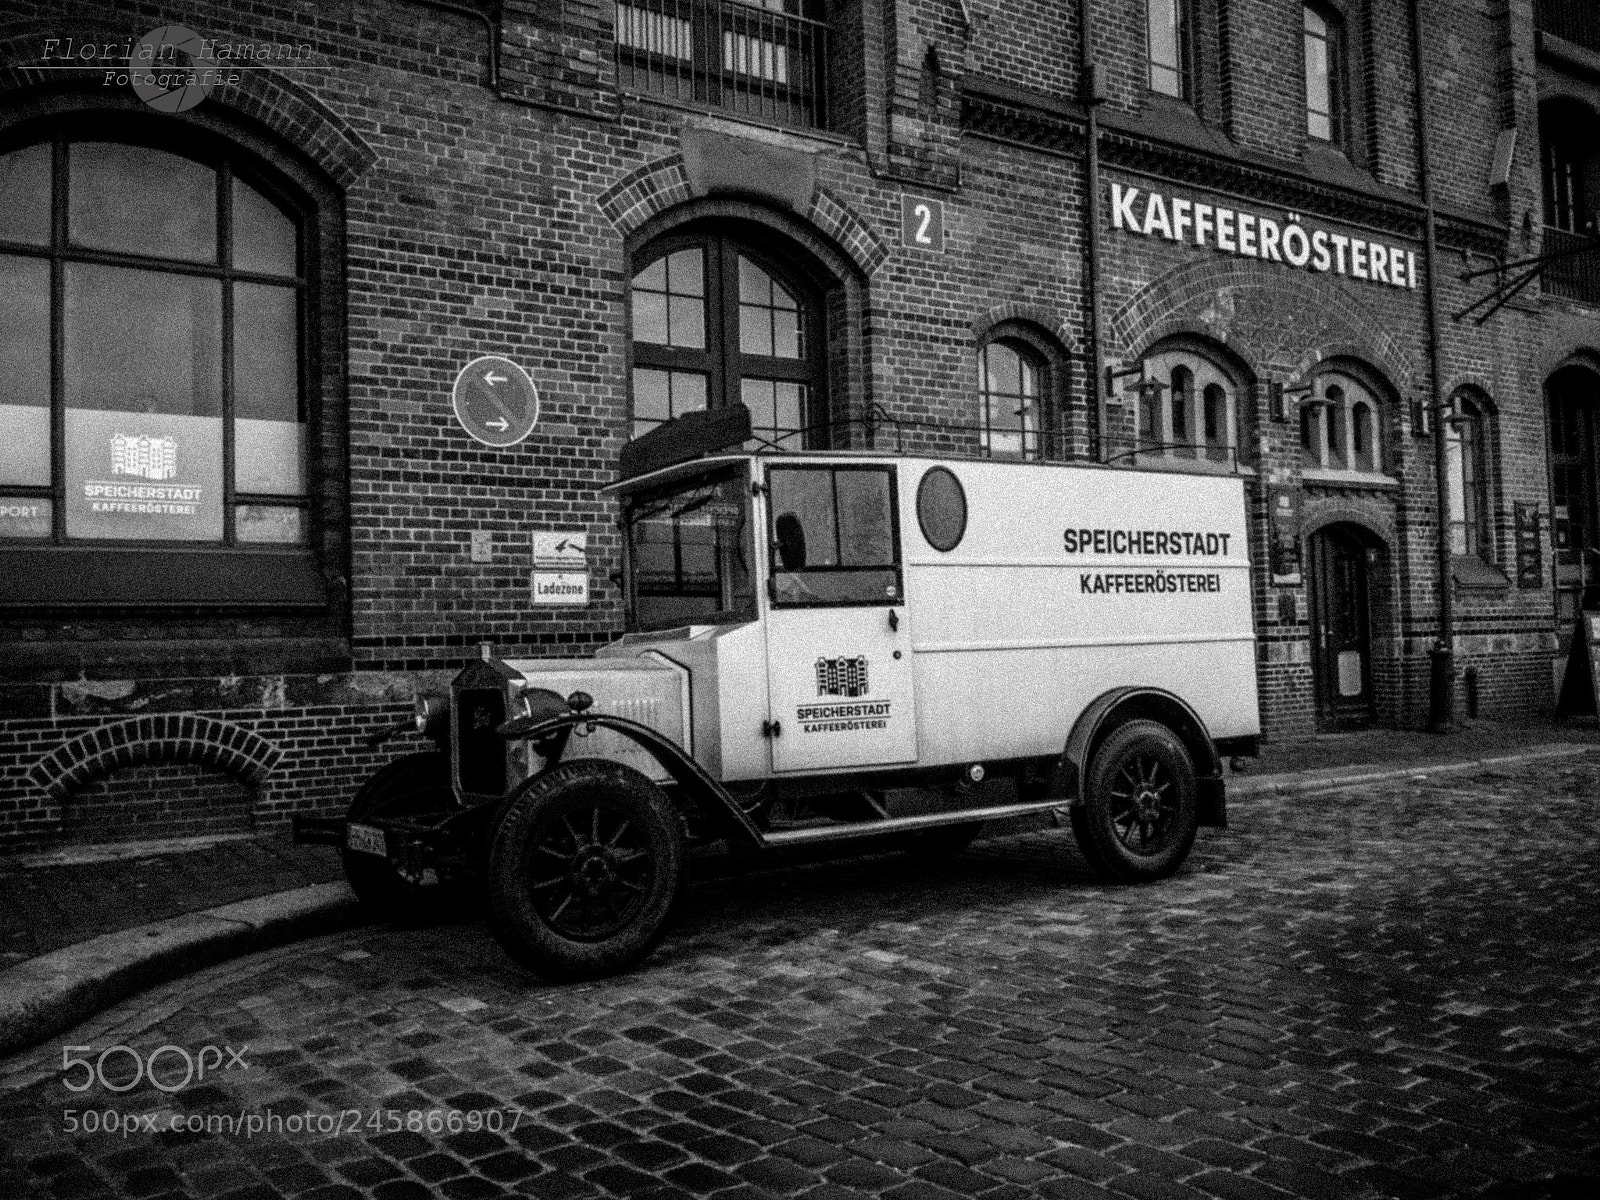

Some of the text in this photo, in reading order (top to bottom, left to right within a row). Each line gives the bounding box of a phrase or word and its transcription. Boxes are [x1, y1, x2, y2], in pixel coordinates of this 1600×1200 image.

[914, 204, 931, 243] 2
[1111, 183, 1416, 288] KAFFEERÖSTEREI
[84, 485, 201, 501] SPEICHERSTADT
[92, 501, 197, 515] KAFFEERÖSTEREI
[1063, 528, 1231, 555] SPEICHERSTADT
[537, 583, 583, 595] Ladezone
[1080, 569, 1220, 593] KAFFEERÖSTEREI
[797, 703, 891, 719] SPEICHERSTADT
[804, 720, 886, 733] KAFFEERÖSTEREI
